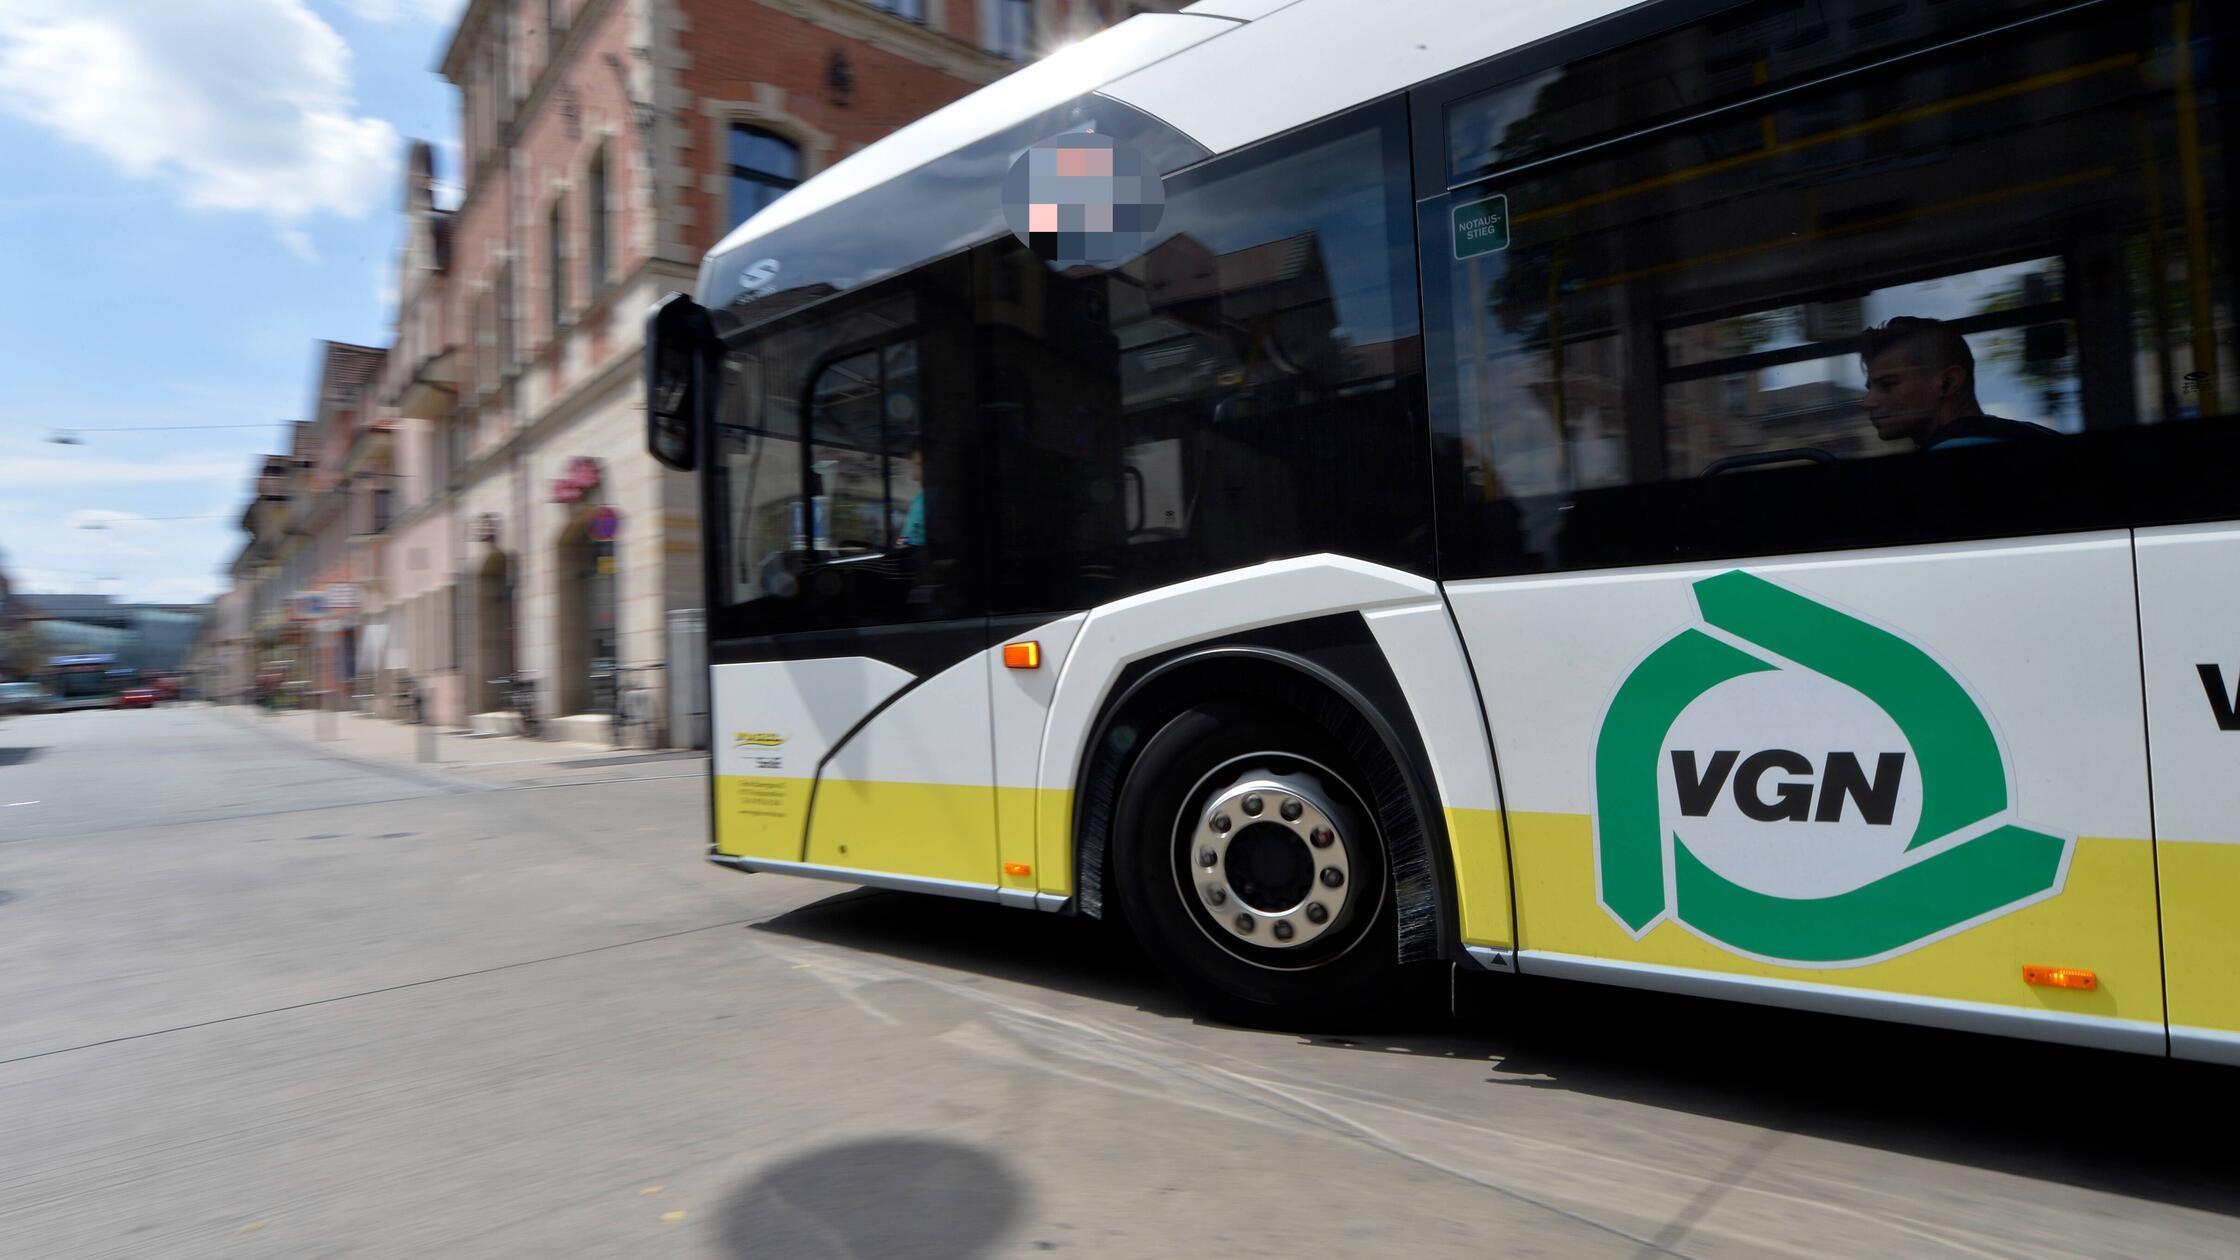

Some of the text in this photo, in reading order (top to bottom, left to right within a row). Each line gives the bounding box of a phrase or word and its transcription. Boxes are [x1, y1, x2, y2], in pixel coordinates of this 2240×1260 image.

[1459, 214, 1501, 232] NOTAUS-
[1467, 225, 1495, 240] STIEG
[1670, 749, 1906, 825] VGN
